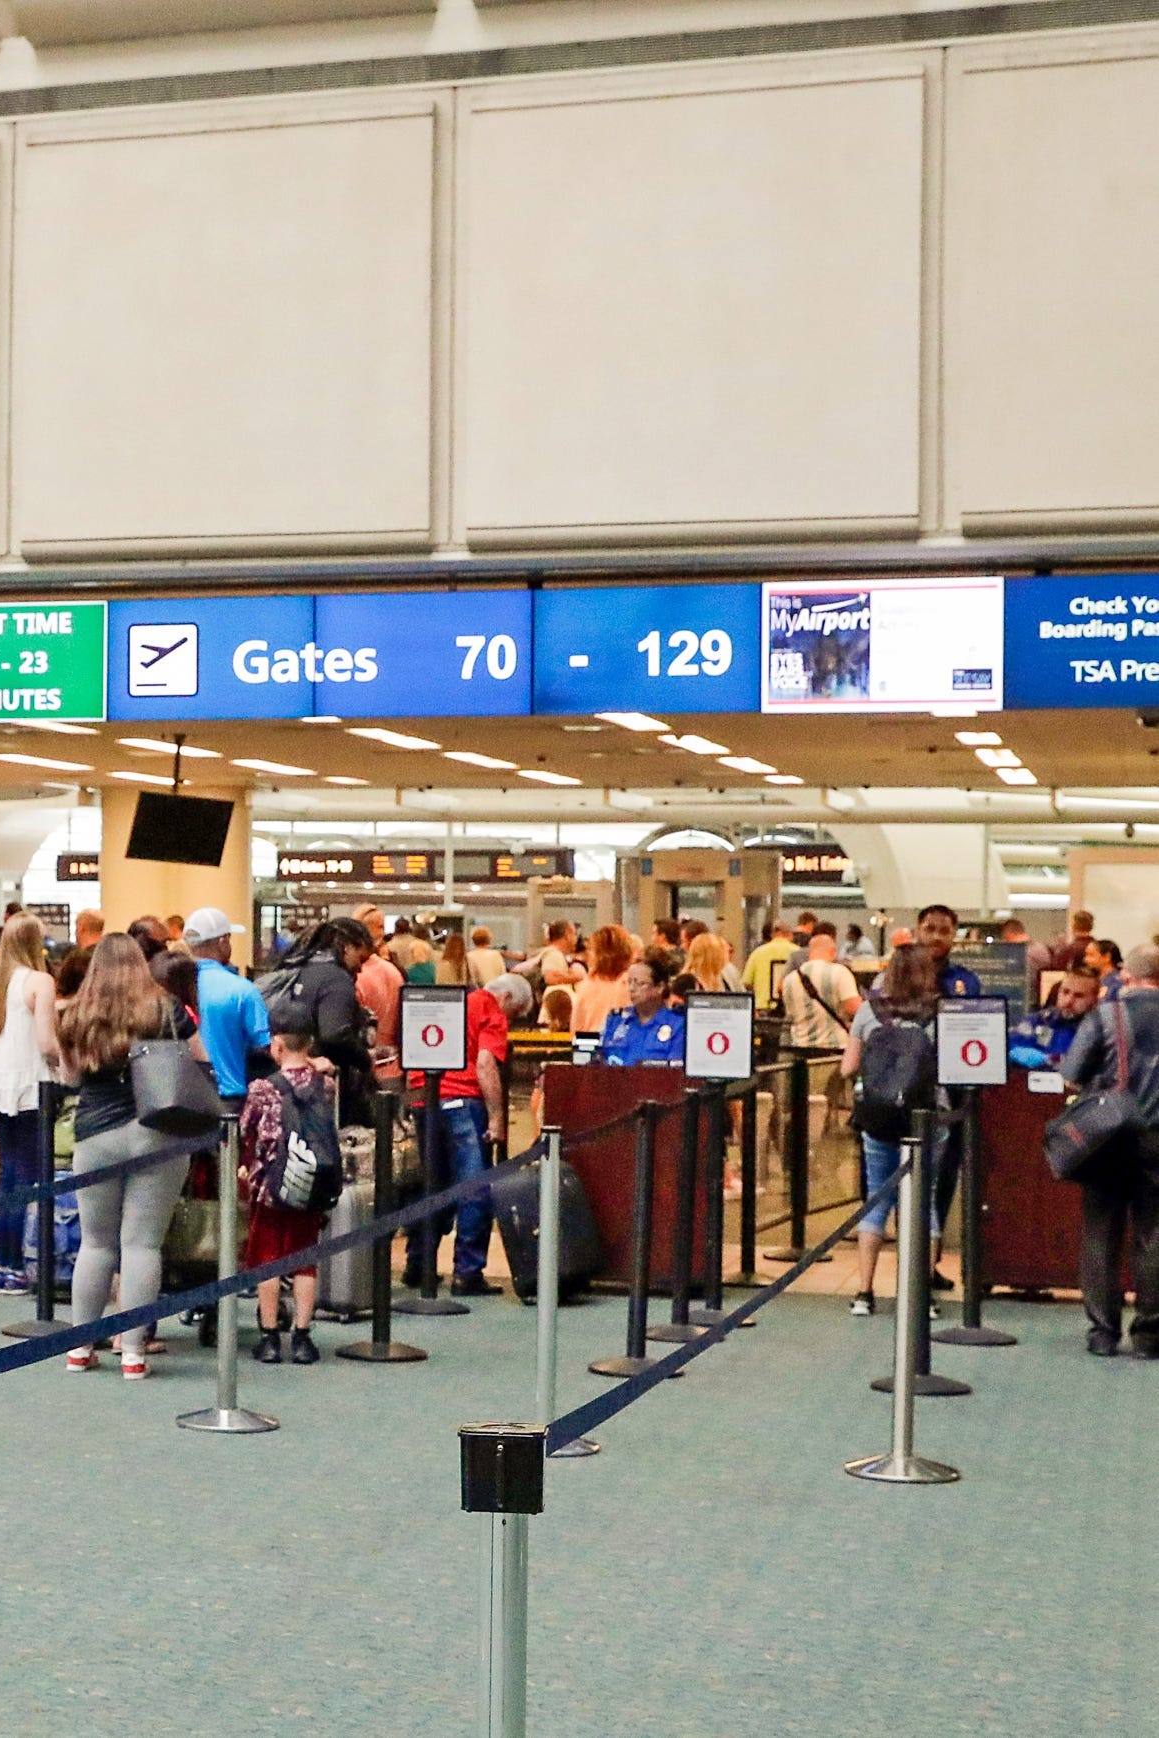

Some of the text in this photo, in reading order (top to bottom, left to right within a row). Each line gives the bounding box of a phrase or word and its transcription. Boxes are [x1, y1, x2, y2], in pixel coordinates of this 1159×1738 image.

[1069, 595, 1128, 615] Check
[12, 611, 73, 635] TIME
[1039, 618, 1128, 641] Boarding
[18, 650, 49, 674] 23
[232, 639, 378, 684] Gates
[455, 634, 518, 680] 70
[637, 629, 733, 677] 129
[1069, 659, 1117, 683] TSA
